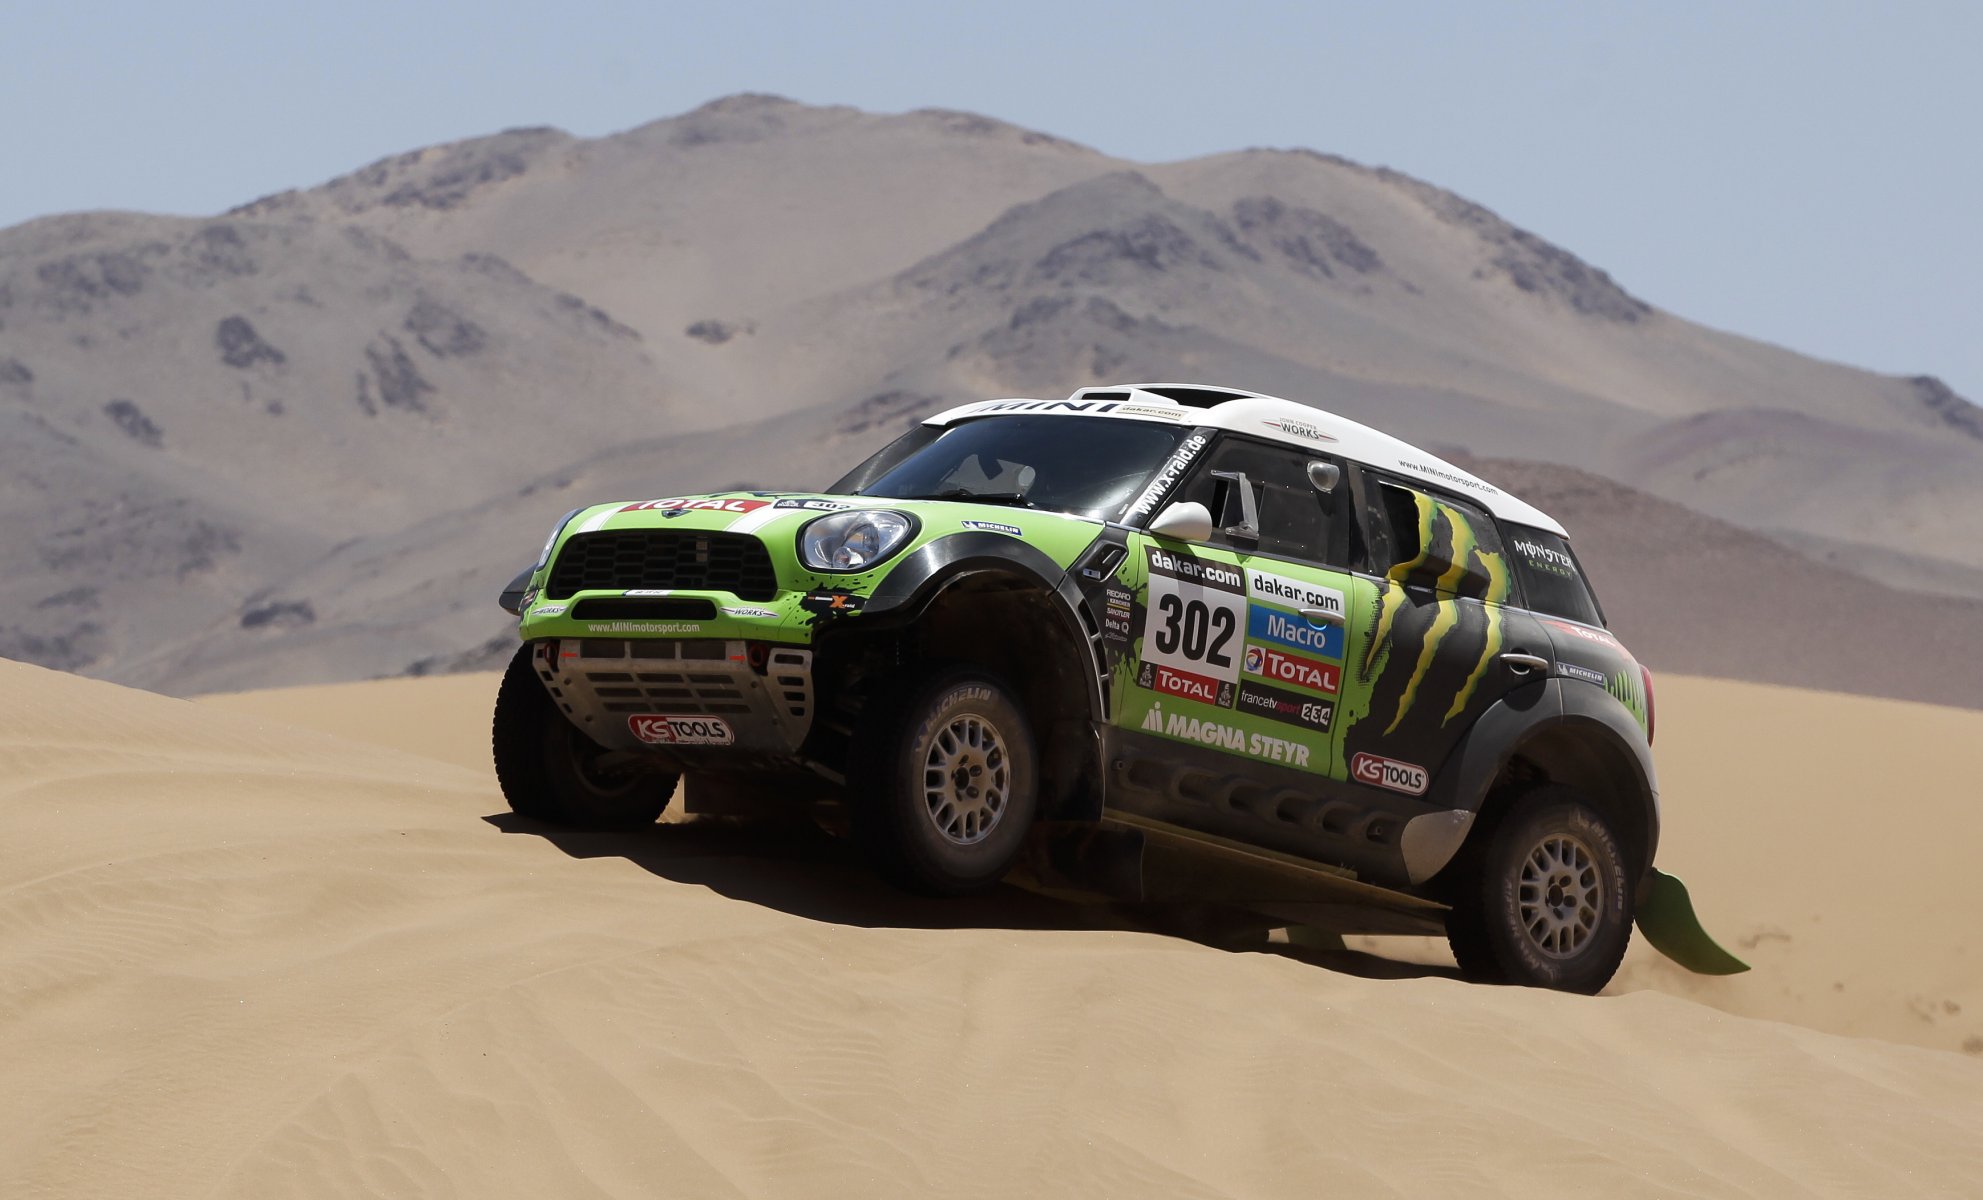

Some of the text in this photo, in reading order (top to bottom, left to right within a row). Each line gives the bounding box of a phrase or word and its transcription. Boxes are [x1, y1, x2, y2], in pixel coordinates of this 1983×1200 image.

[1121, 406, 1184, 418] dakar.com
[1280, 422, 1320, 440] WORKS
[1136, 434, 1207, 515] www.x-raid.de
[637, 498, 747, 512] TOTAL
[977, 522, 1019, 534] MICHELIN
[1513, 539, 1578, 574] MONSTER
[1151, 549, 1241, 588] dakar.com
[1528, 559, 1573, 581] ENERGY
[1106, 588, 1131, 601] RECARO
[1253, 574, 1340, 612] dakar.com
[734, 607, 764, 617] WORKS
[587, 621, 701, 635] www.MINImotorsport.com
[1105, 618, 1130, 635] Delta Q
[1155, 593, 1236, 669] 302
[1267, 614, 1326, 650] Macro
[1571, 625, 1616, 647] TOTAL
[1268, 653, 1336, 691] TOTAL
[1569, 667, 1603, 682] MICHELIN
[1159, 669, 1214, 700] TOTAL
[1165, 712, 1311, 768] MAGNA STEYR
